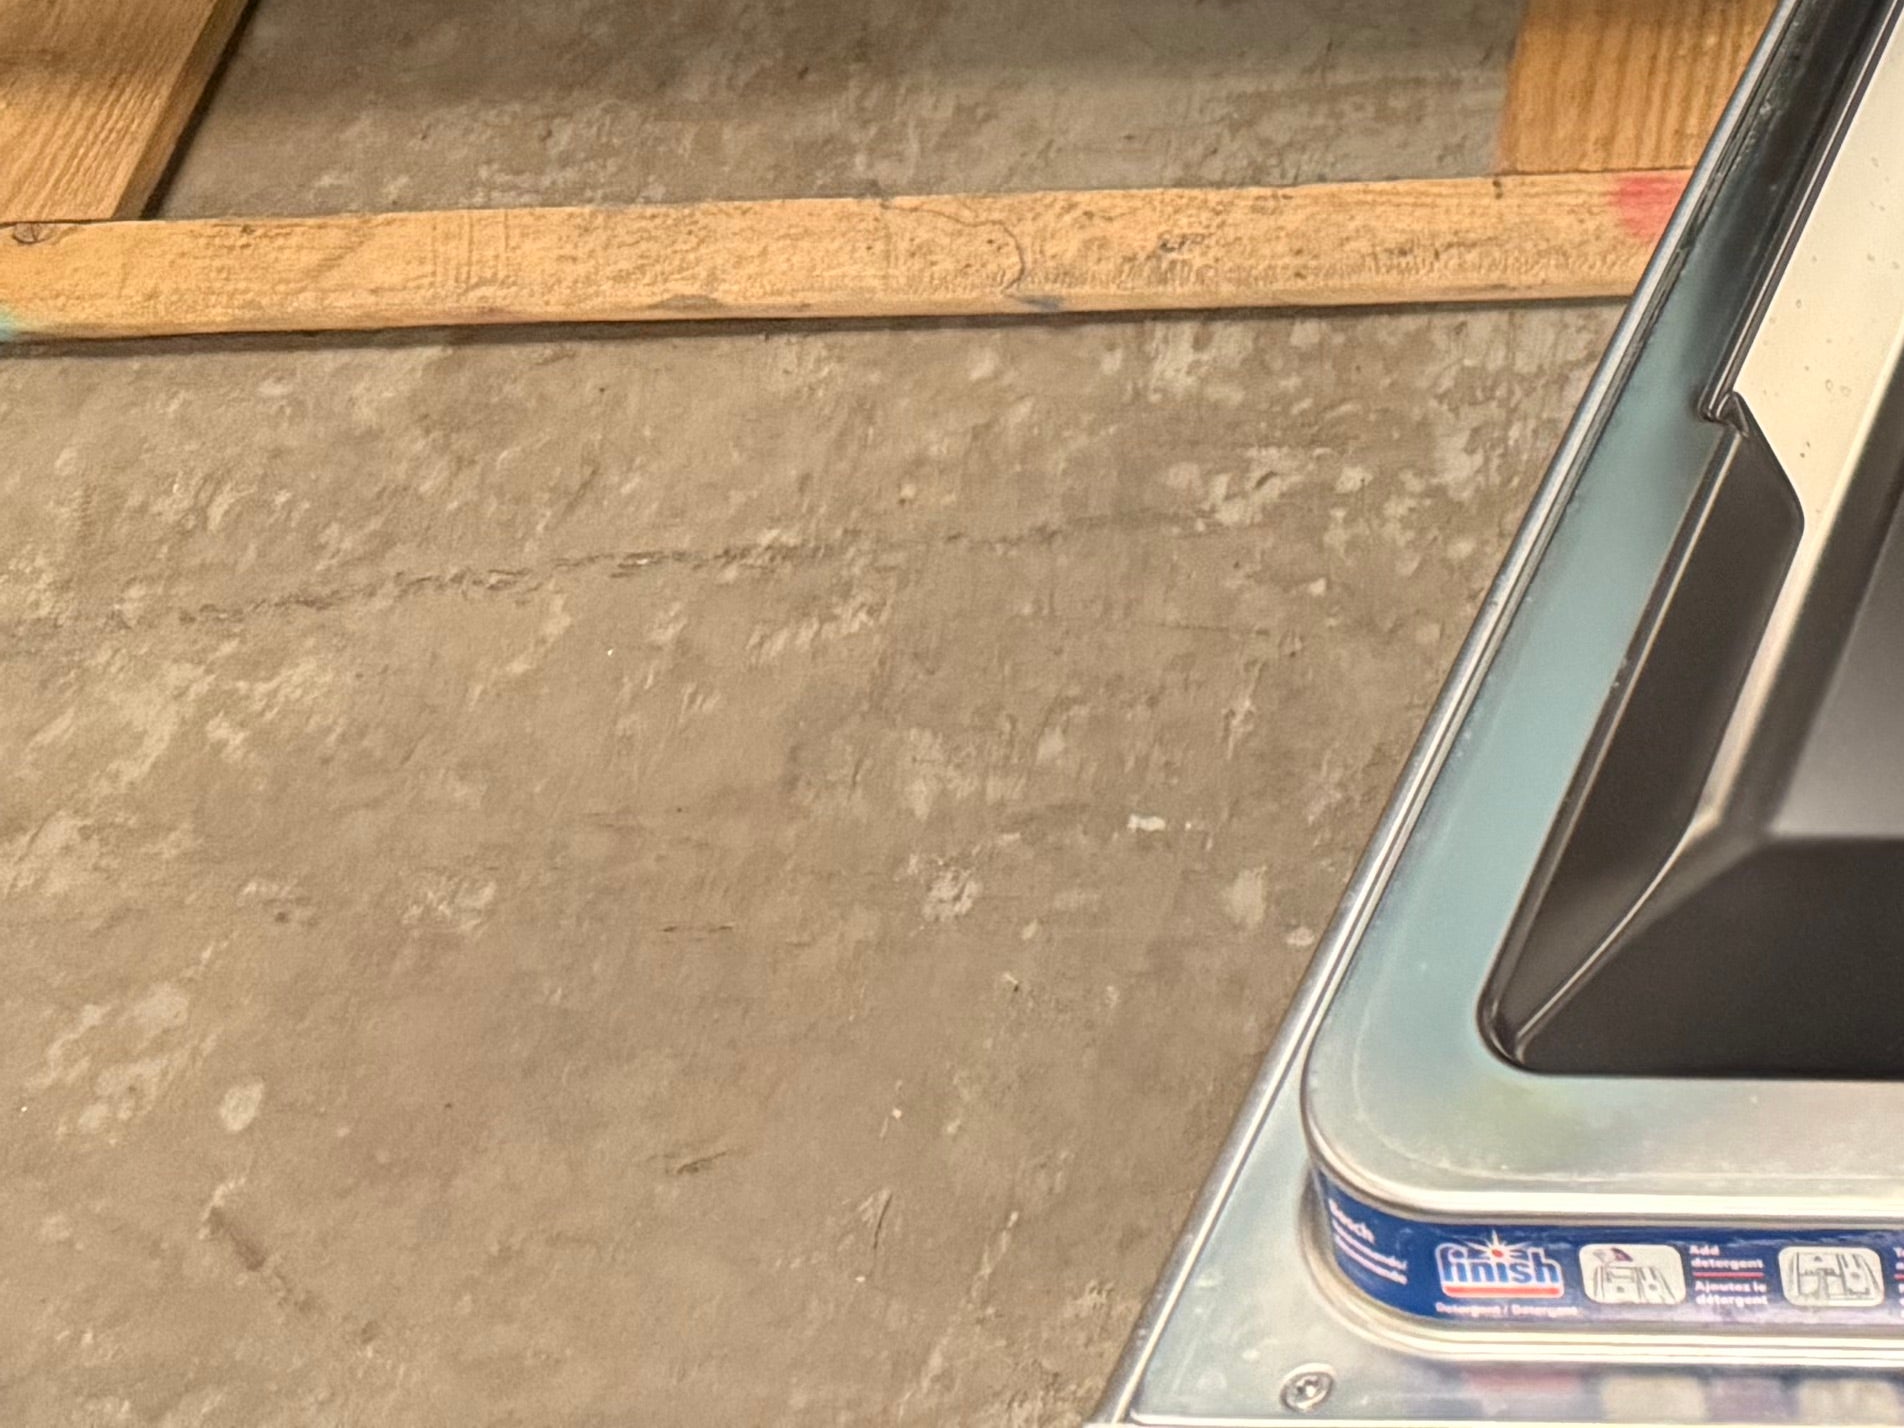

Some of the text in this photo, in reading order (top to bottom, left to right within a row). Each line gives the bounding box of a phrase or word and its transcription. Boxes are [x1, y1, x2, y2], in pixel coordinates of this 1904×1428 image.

[1689, 1244, 1720, 1256] Add
[1434, 1242, 1563, 1286] finish
[1690, 1257, 1764, 1271] detergent
